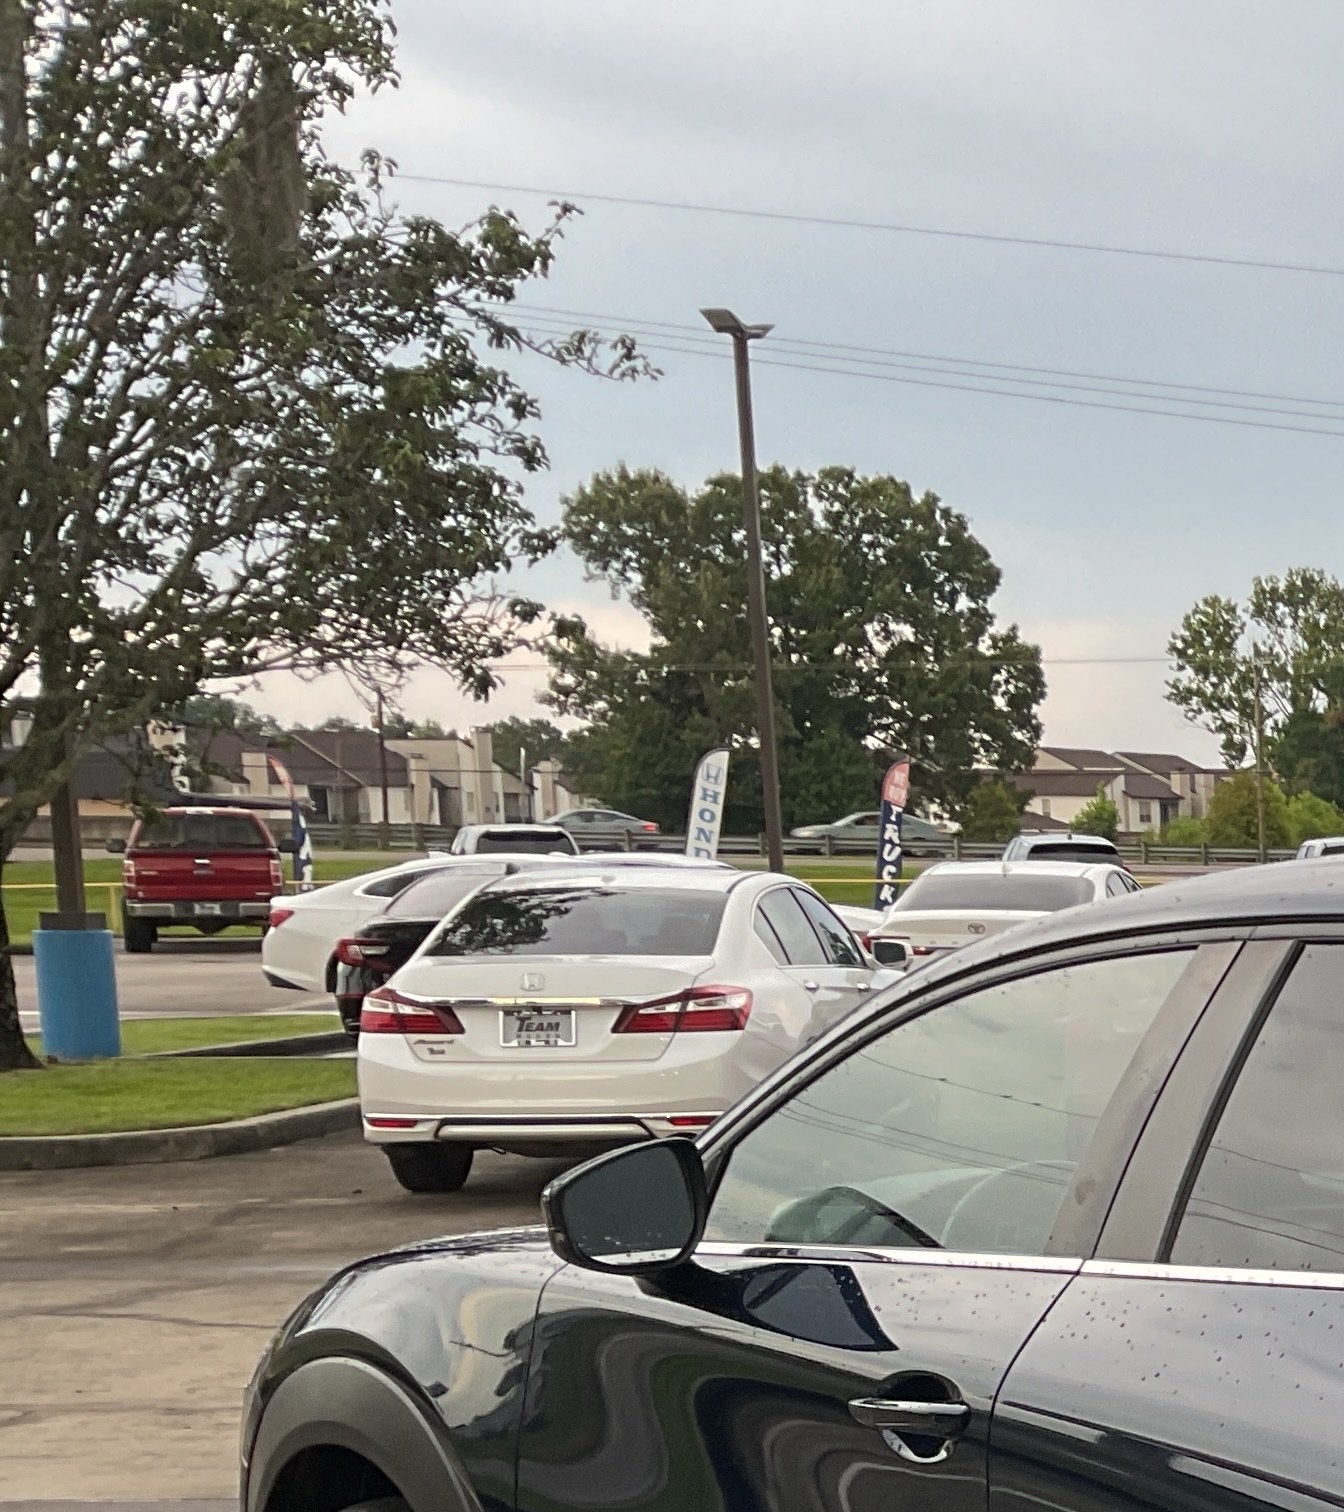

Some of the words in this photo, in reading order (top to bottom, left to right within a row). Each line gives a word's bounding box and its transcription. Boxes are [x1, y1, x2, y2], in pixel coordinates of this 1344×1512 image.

[694, 786, 721, 861] HOND
[879, 804, 903, 910] TRUCK
[516, 1016, 561, 1033] TEAM
